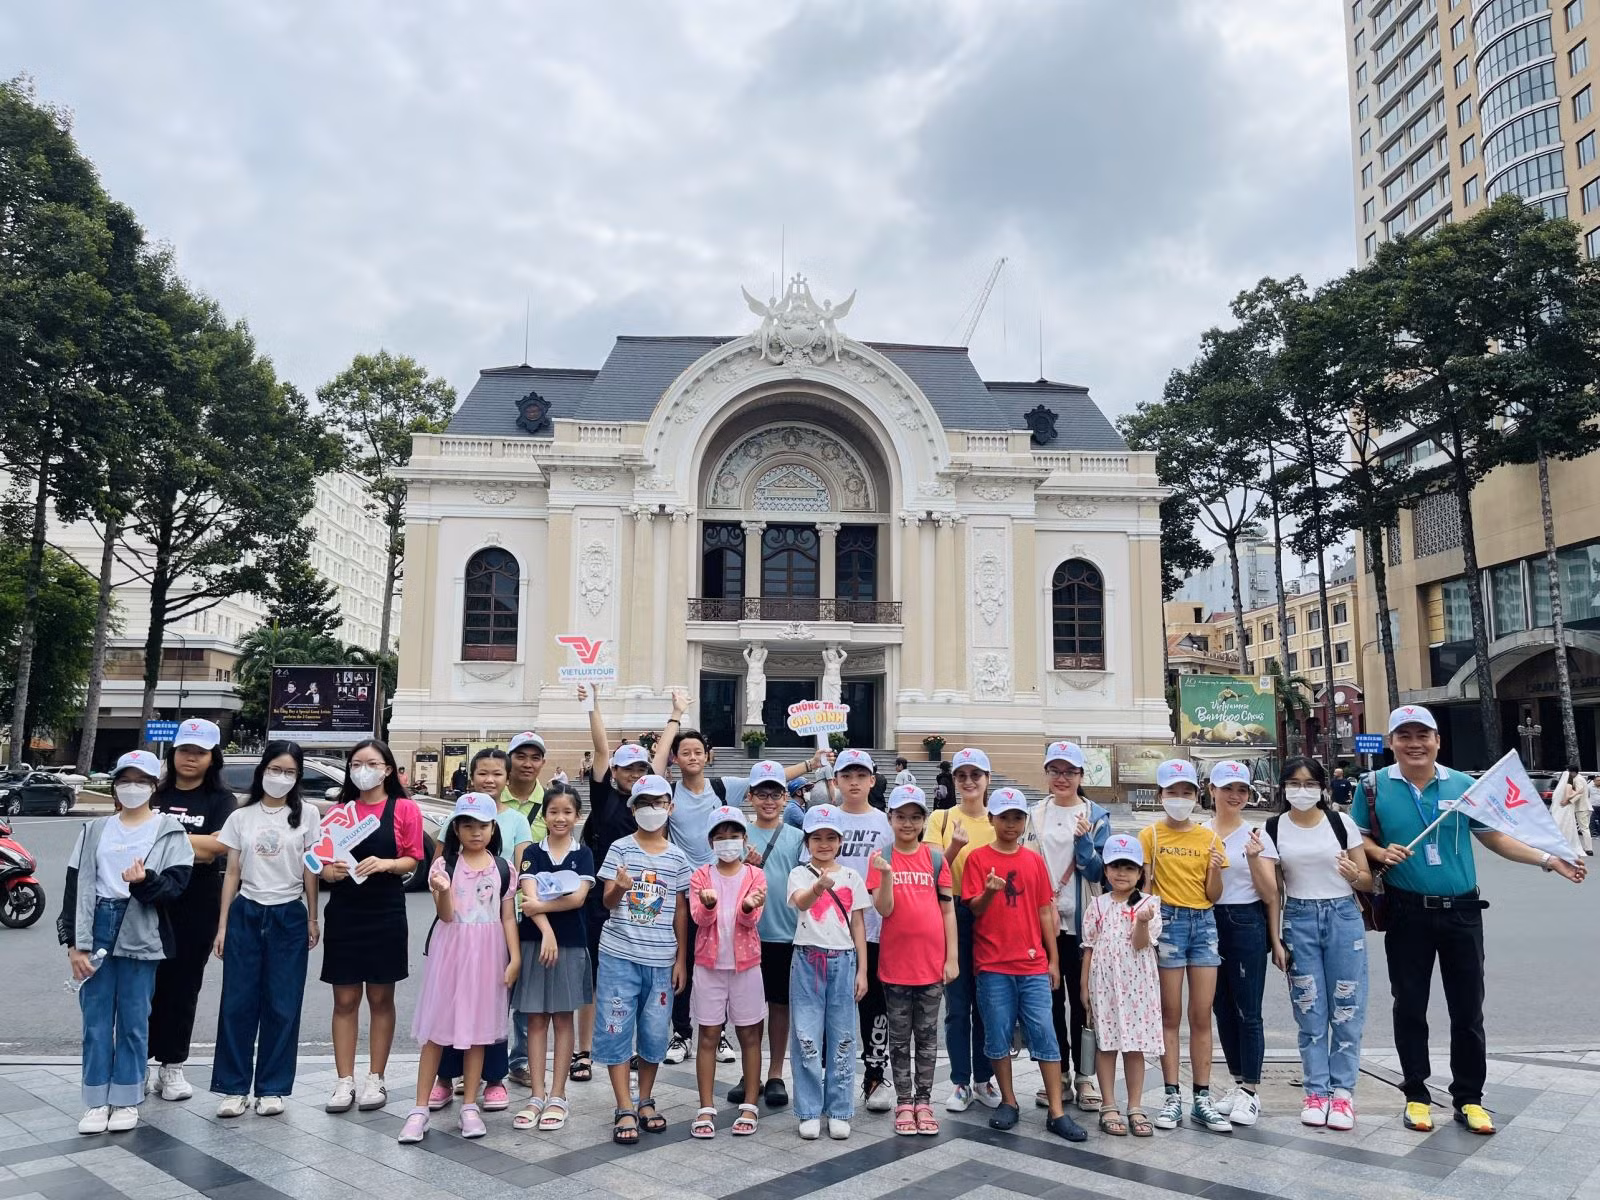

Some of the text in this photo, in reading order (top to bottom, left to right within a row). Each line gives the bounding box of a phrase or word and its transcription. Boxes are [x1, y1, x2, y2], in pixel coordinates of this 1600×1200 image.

[561, 668, 614, 676] VIETLUXTOUR
[823, 702, 834, 710] TA
[1210, 700, 1249, 712] Vietnamese
[791, 714, 811, 728] GIA
[1195, 707, 1240, 722] Bamboo
[797, 724, 846, 734] VIETLUXTOUR
[337, 816, 375, 848] VIETLUXTOUR
[842, 829, 881, 842] ON'T
[842, 843, 875, 857] UIT
[892, 871, 934, 887] SITIVITY
[632, 882, 650, 892] SMIC
